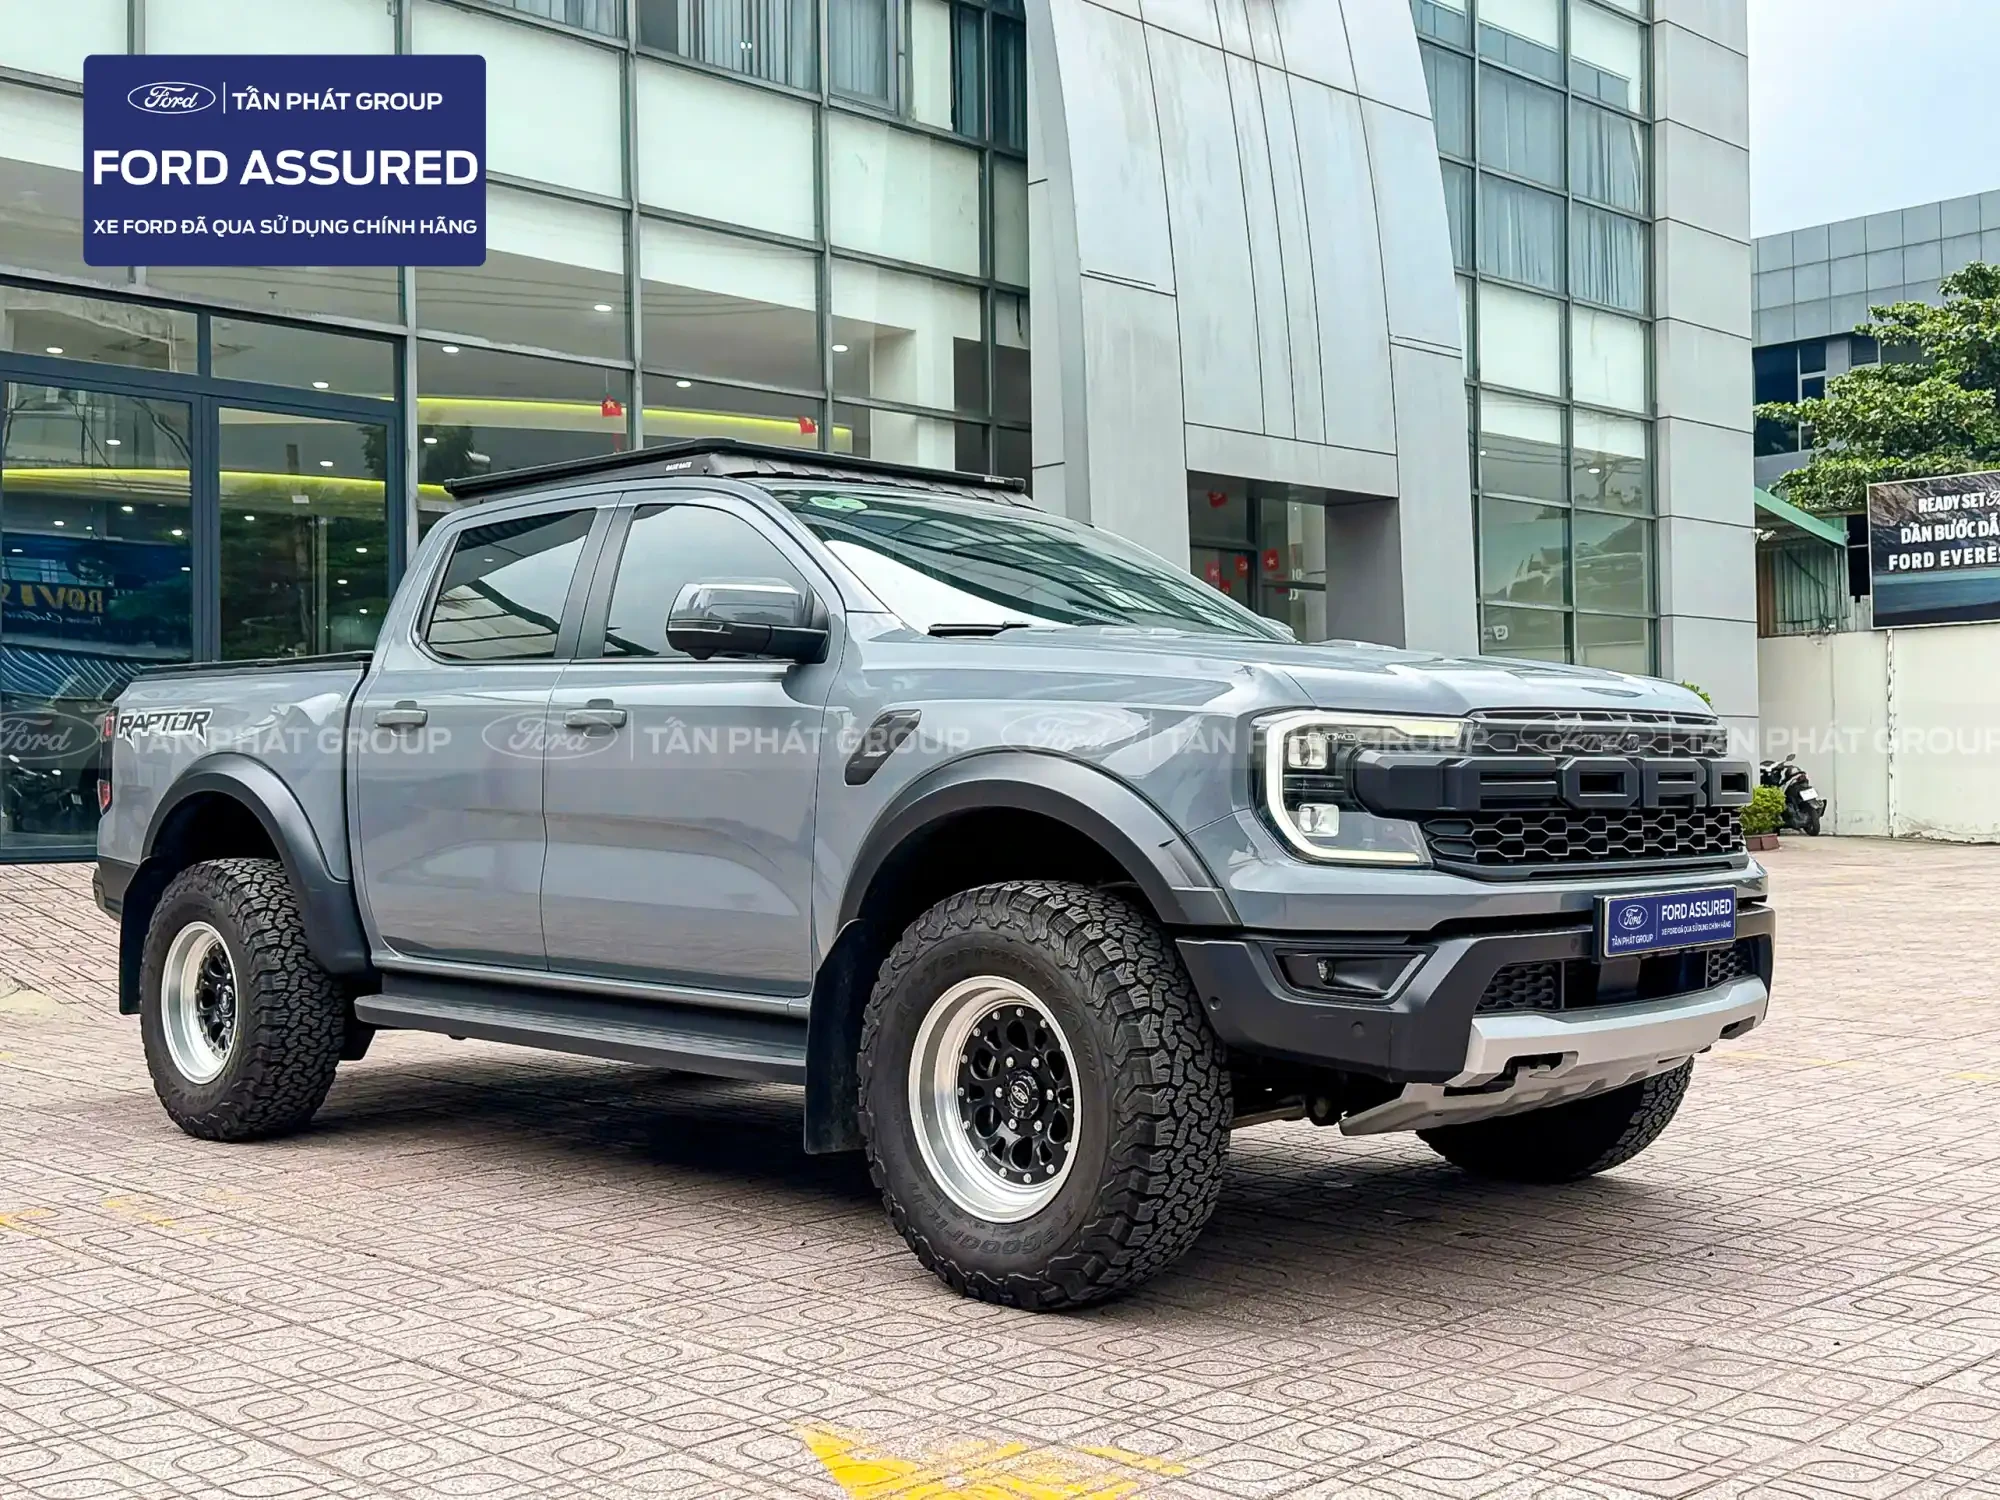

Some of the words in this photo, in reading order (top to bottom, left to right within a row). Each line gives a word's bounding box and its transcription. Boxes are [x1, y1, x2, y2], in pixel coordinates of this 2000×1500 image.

[1918, 494, 1960, 513] READY
[1961, 491, 1986, 510] SET
[1934, 518, 1977, 541] BƯỚC
[1888, 551, 1935, 571] FORD
[1940, 546, 2000, 567] EVERE
[117, 709, 213, 748] RAPTOR
[1450, 754, 1753, 813] FORD
[1624, 908, 1643, 926] Ford
[1661, 903, 1688, 921] FORD
[1688, 898, 1732, 918] ASSURED
[1635, 933, 1654, 944] GROUP
